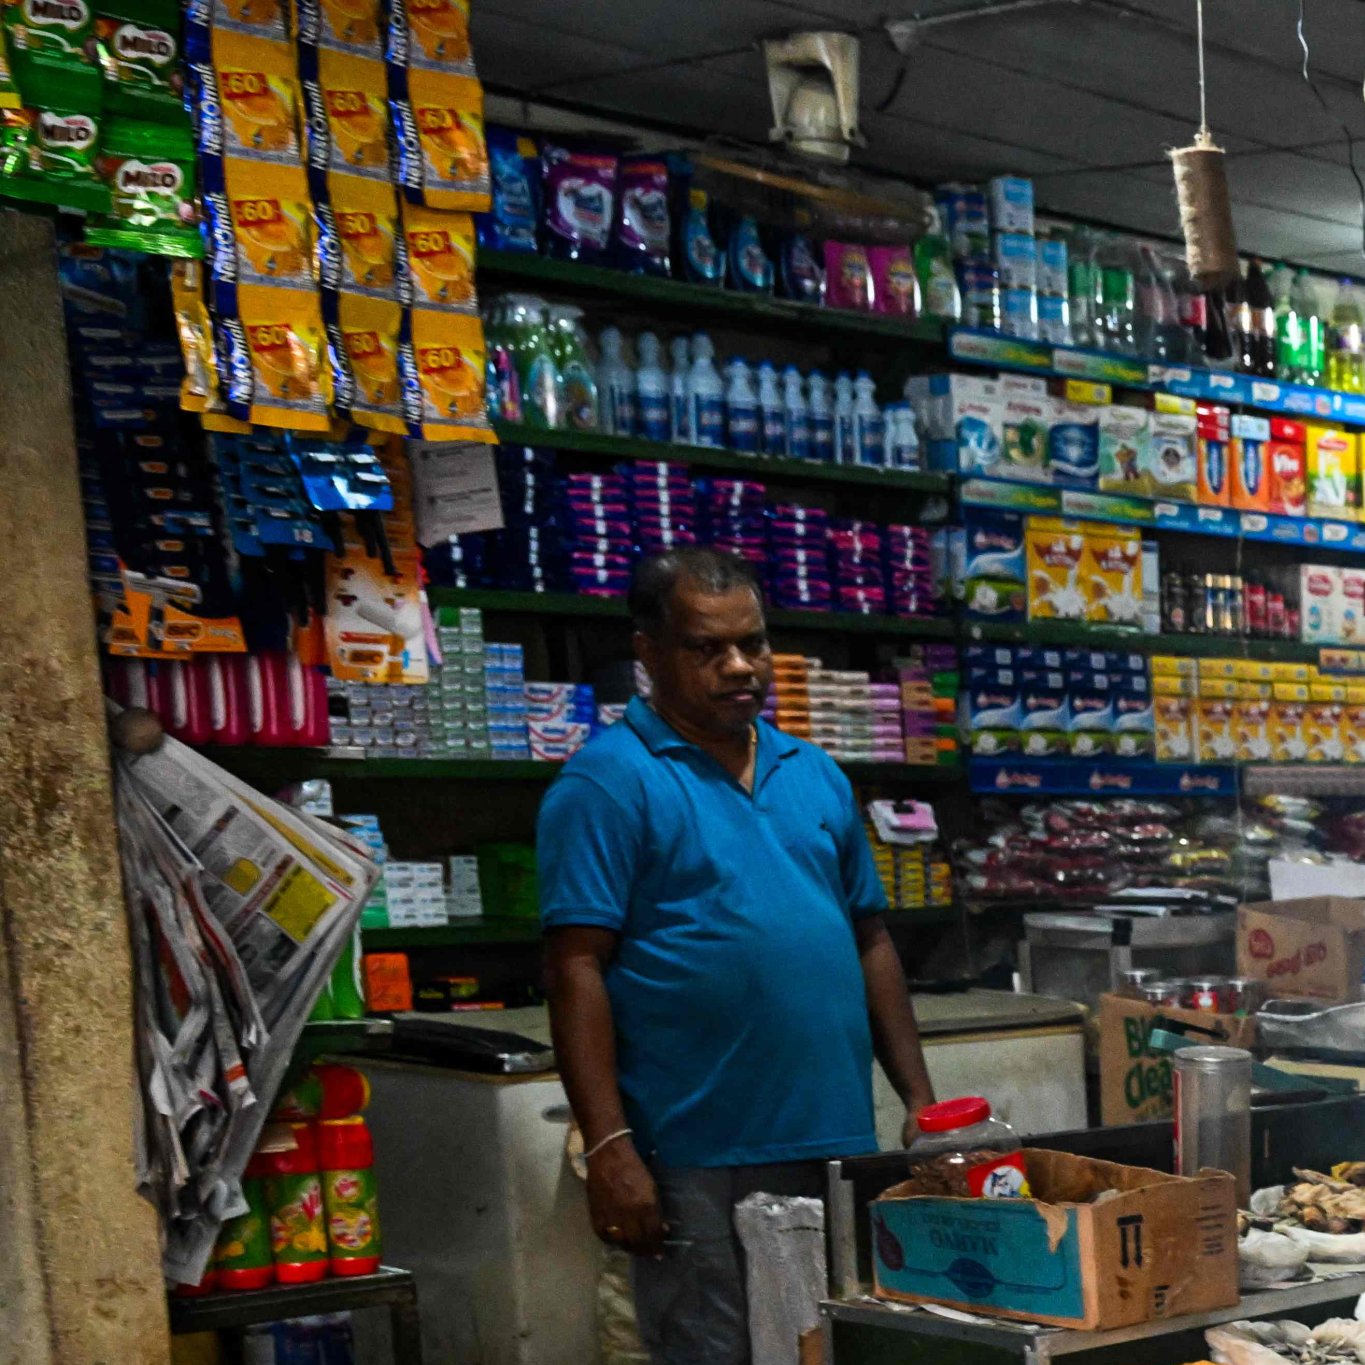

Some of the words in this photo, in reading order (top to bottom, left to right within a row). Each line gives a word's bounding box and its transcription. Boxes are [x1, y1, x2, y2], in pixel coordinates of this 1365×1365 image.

[242, 200, 274, 221] 60
[415, 232, 445, 252] 60
[426, 349, 456, 369] 60
